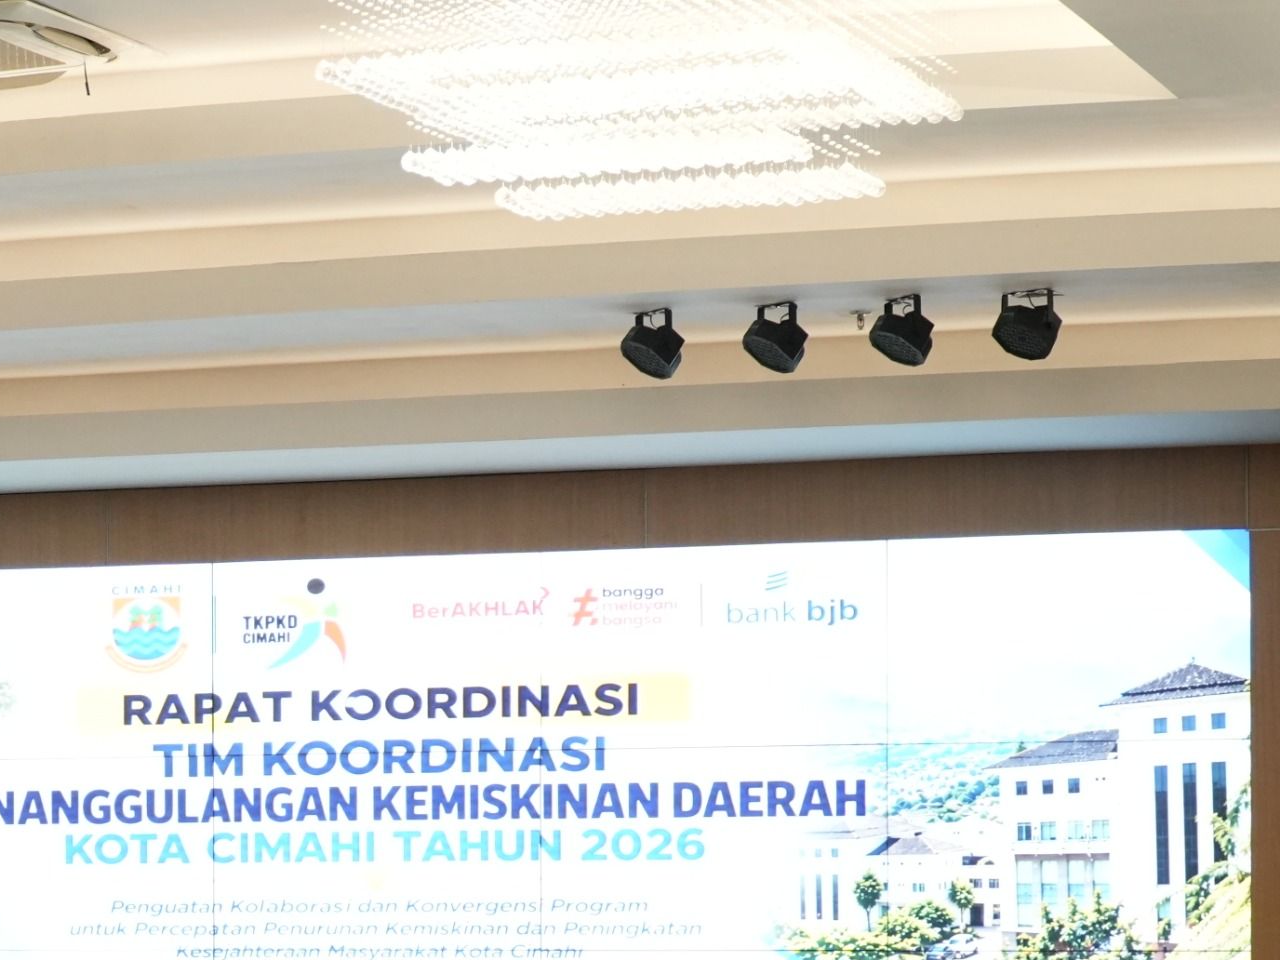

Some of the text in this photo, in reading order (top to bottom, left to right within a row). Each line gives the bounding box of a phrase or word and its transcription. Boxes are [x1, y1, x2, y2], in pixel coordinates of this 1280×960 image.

[111, 584, 183, 595] CIMAHI
[601, 587, 664, 600] bangga
[412, 599, 545, 619] BerAKHLAK
[727, 599, 859, 626] bank bjb
[242, 614, 298, 630] TKPKD
[242, 632, 291, 644] CIMAHI
[123, 683, 639, 726] RAPAT KOORDINASI
[153, 736, 606, 778] TIM KOORDINASI
[373, 782, 659, 822] KEMISKINAN
[672, 779, 867, 818] DAERAH
[65, 828, 705, 865] KOTA CIMAHI TAHUN 2026
[111, 898, 649, 916] Penguatan Kolaborasi dan Konvergensi Program
[70, 920, 703, 939] untuk Percepatan Penurunan Kemiskinan dan Peningkatan
[177, 944, 584, 960] Kesejahteraan Masyarakat Kota Cimahi
